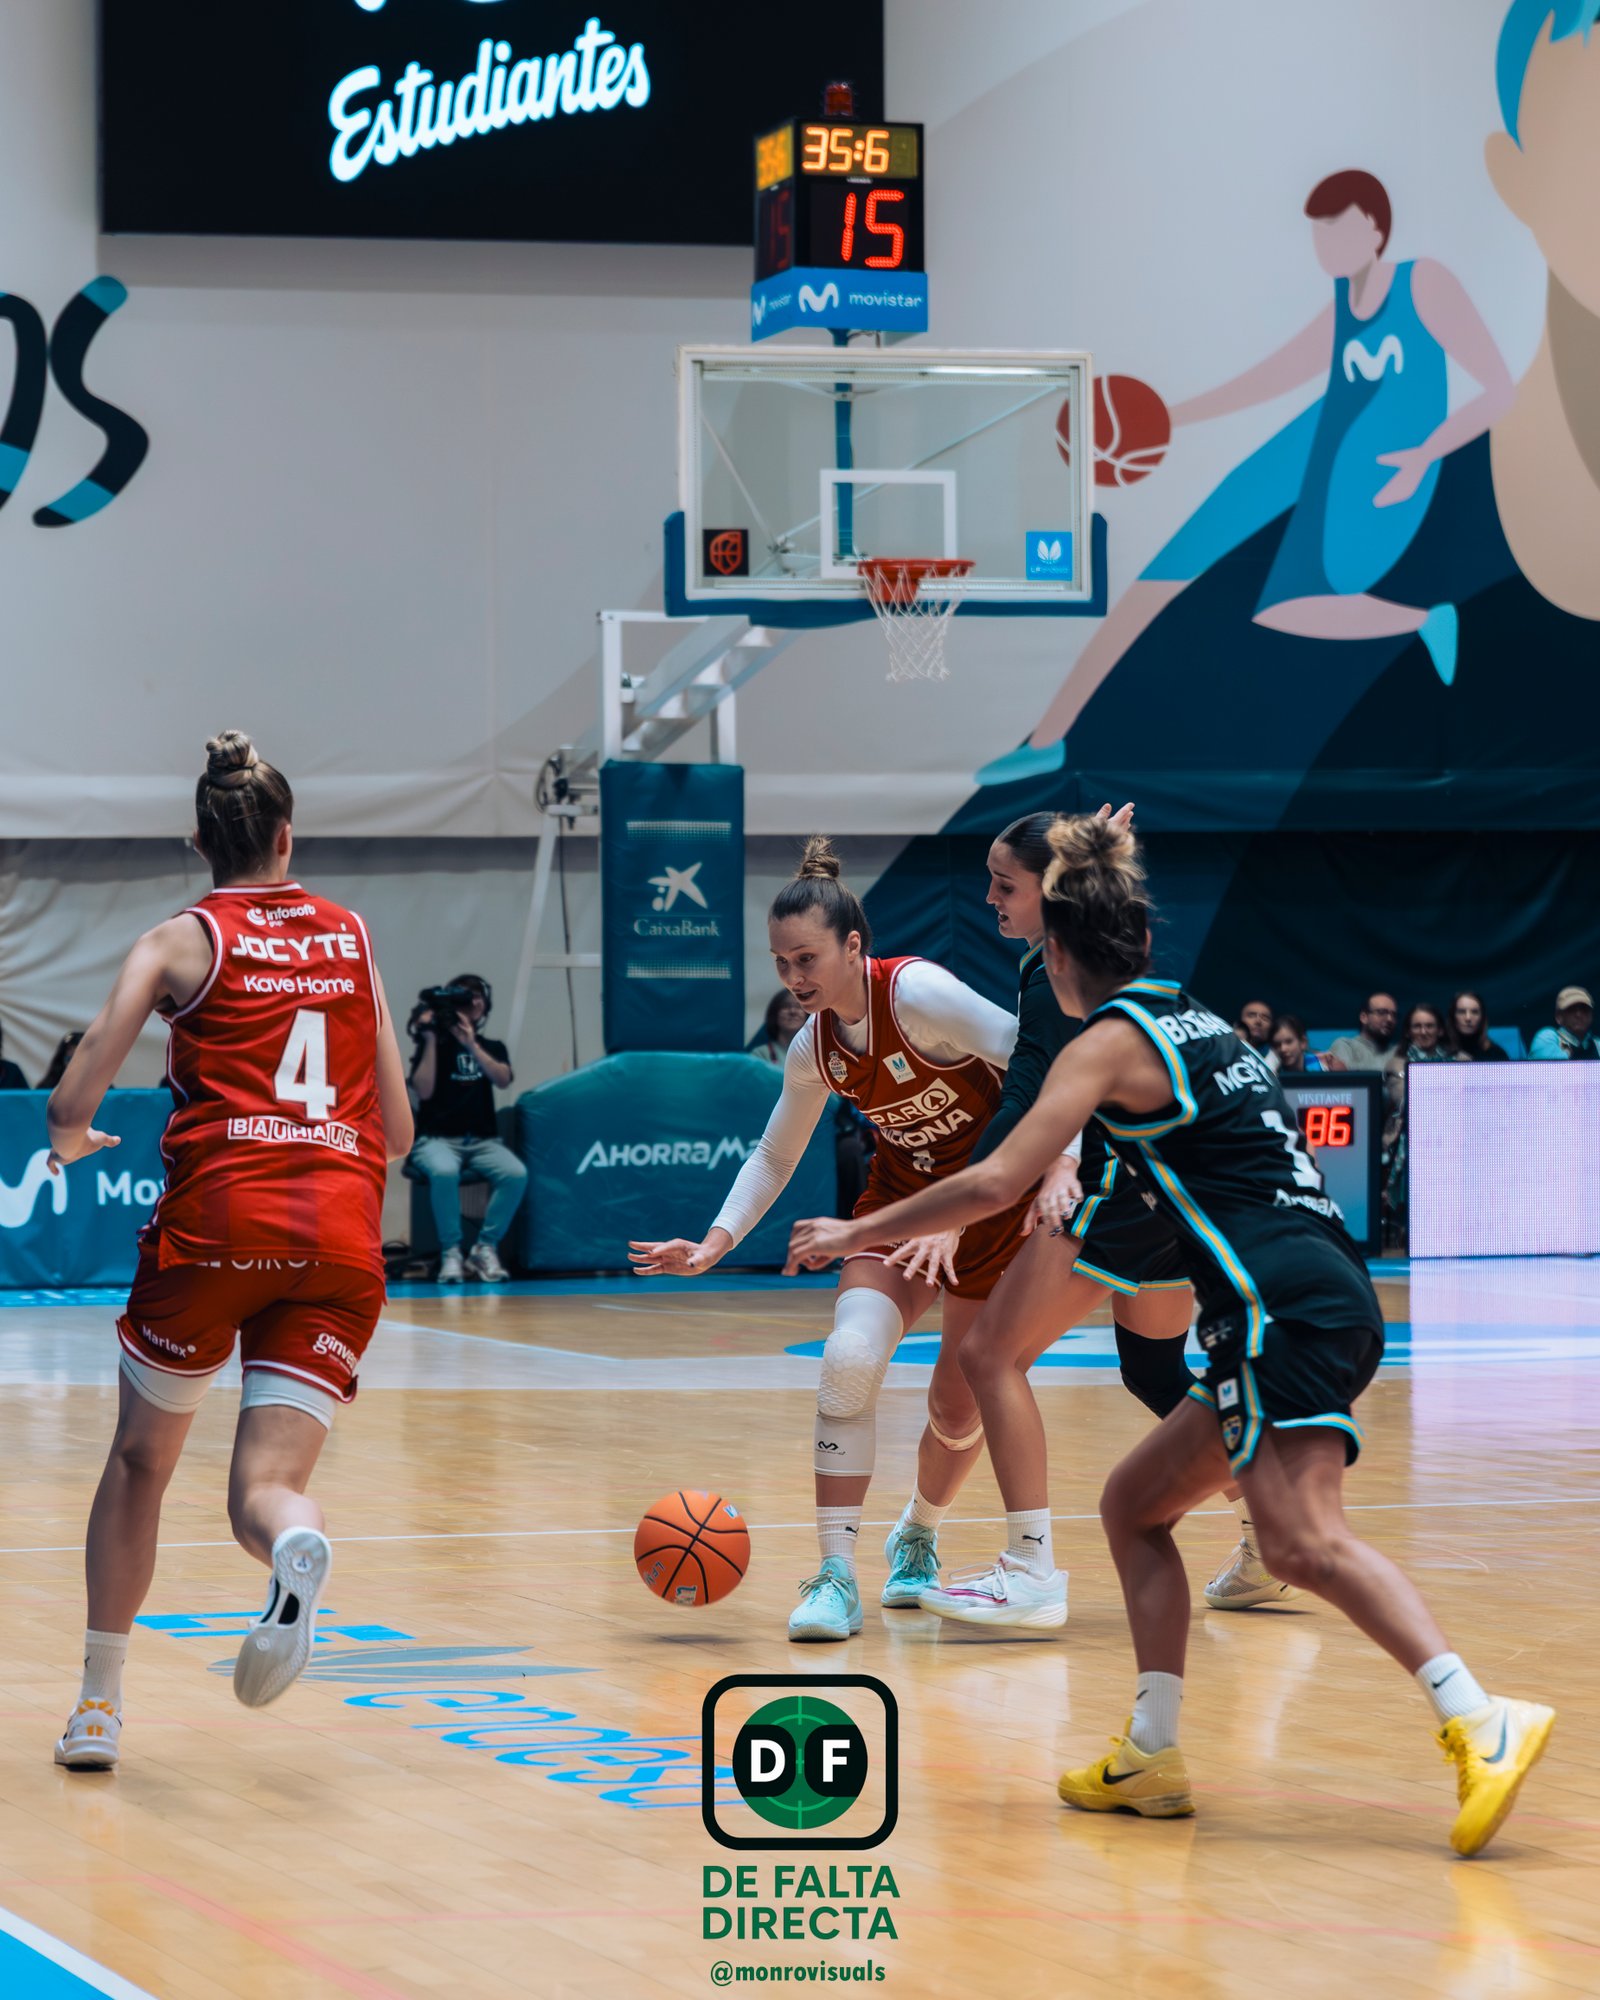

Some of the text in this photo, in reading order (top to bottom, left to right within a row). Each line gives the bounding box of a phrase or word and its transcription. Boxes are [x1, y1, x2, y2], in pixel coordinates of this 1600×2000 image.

[329, 17, 650, 182] Estudiantes
[841, 189, 905, 268] 15
[849, 290, 922, 307] movistar
[266, 903, 316, 921] infosoft
[633, 919, 721, 937] CaixaBank
[243, 975, 355, 994] Kave Home
[274, 1008, 337, 1120] 4
[870, 1105, 923, 1125] PAR
[1298, 1093, 1352, 1105] VISITANTE
[233, 1118, 357, 1150] BAUHAUS
[1306, 1106, 1351, 1147] 86
[97, 1170, 166, 1206] Mo
[142, 1324, 187, 1359] Marlex
